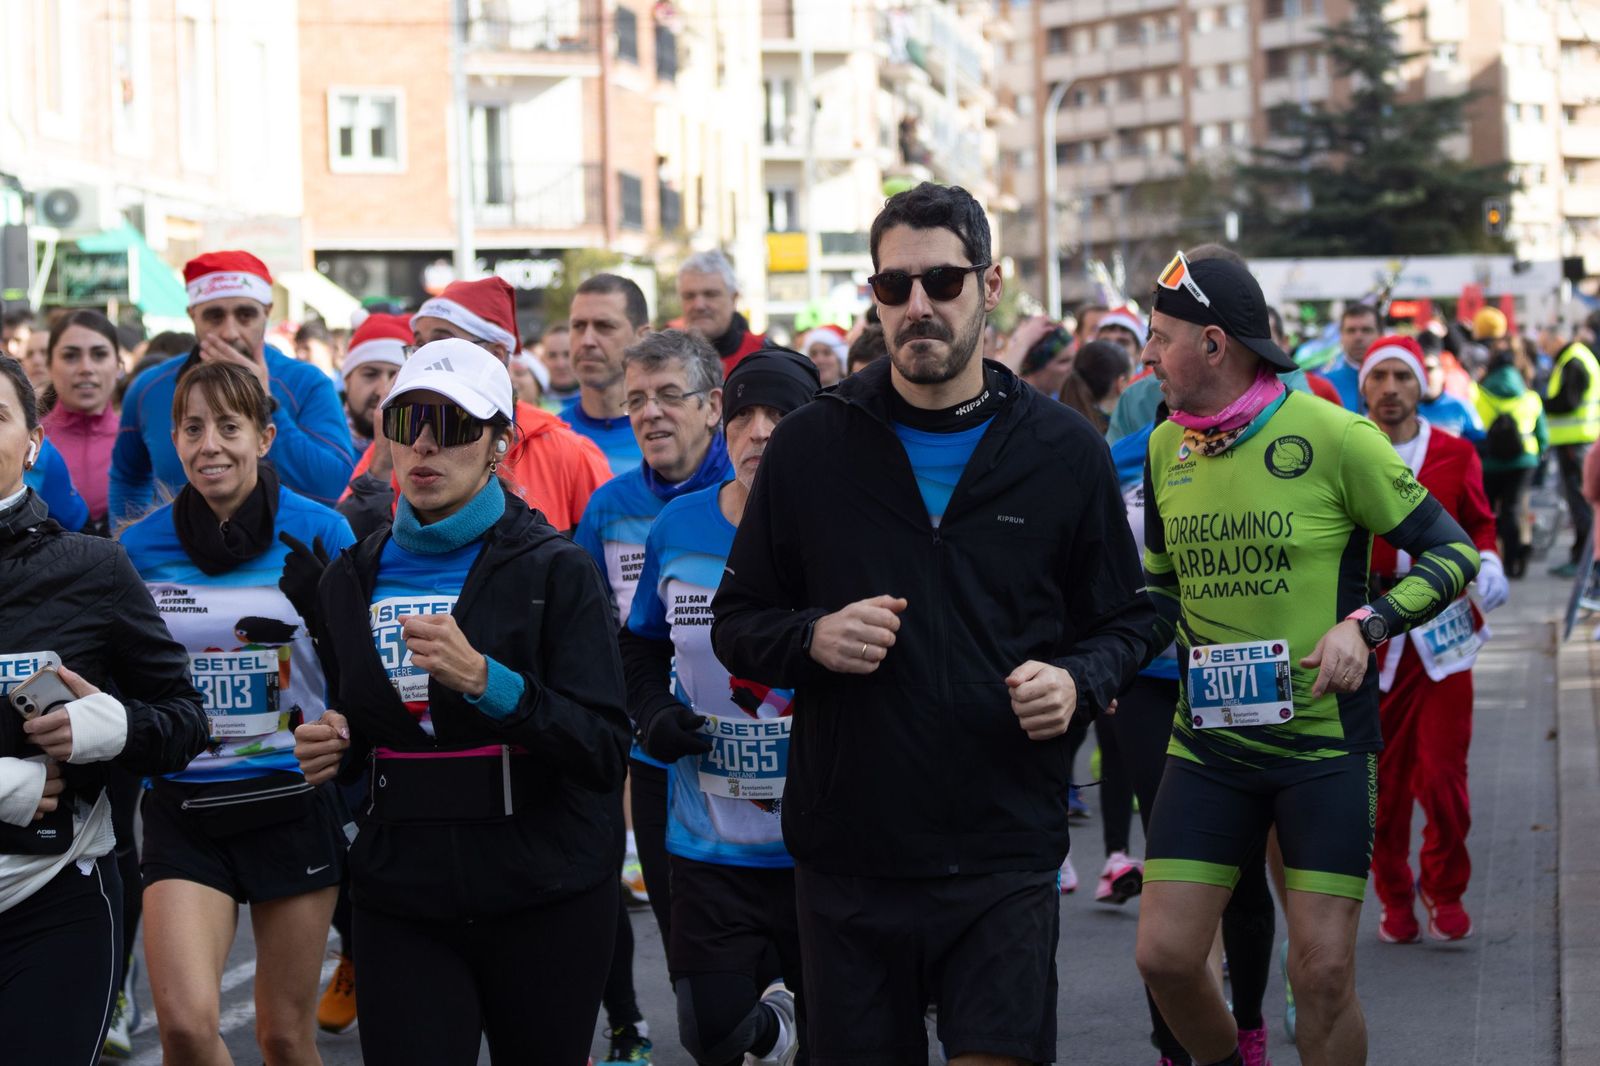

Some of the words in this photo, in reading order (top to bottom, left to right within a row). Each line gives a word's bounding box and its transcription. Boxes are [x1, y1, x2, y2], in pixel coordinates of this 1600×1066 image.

[997, 514, 1025, 525] KIPRUN
[1166, 510, 1294, 547] CORRECAMINOS
[622, 573, 640, 582] SALM
[1181, 578, 1290, 600] SALAMANCA
[675, 595, 687, 604] XLI
[688, 595, 708, 604] SAN
[379, 602, 458, 623] SETE
[674, 606, 714, 615] SILVESTR
[673, 617, 715, 626] SALMANT
[1211, 645, 1277, 664] SETEL
[194, 656, 268, 672] SETEL
[390, 667, 412, 678] TERE
[1202, 664, 1259, 701] 3071
[192, 675, 252, 710] 303
[720, 721, 791, 737] SETEL
[708, 737, 779, 773] 4055
